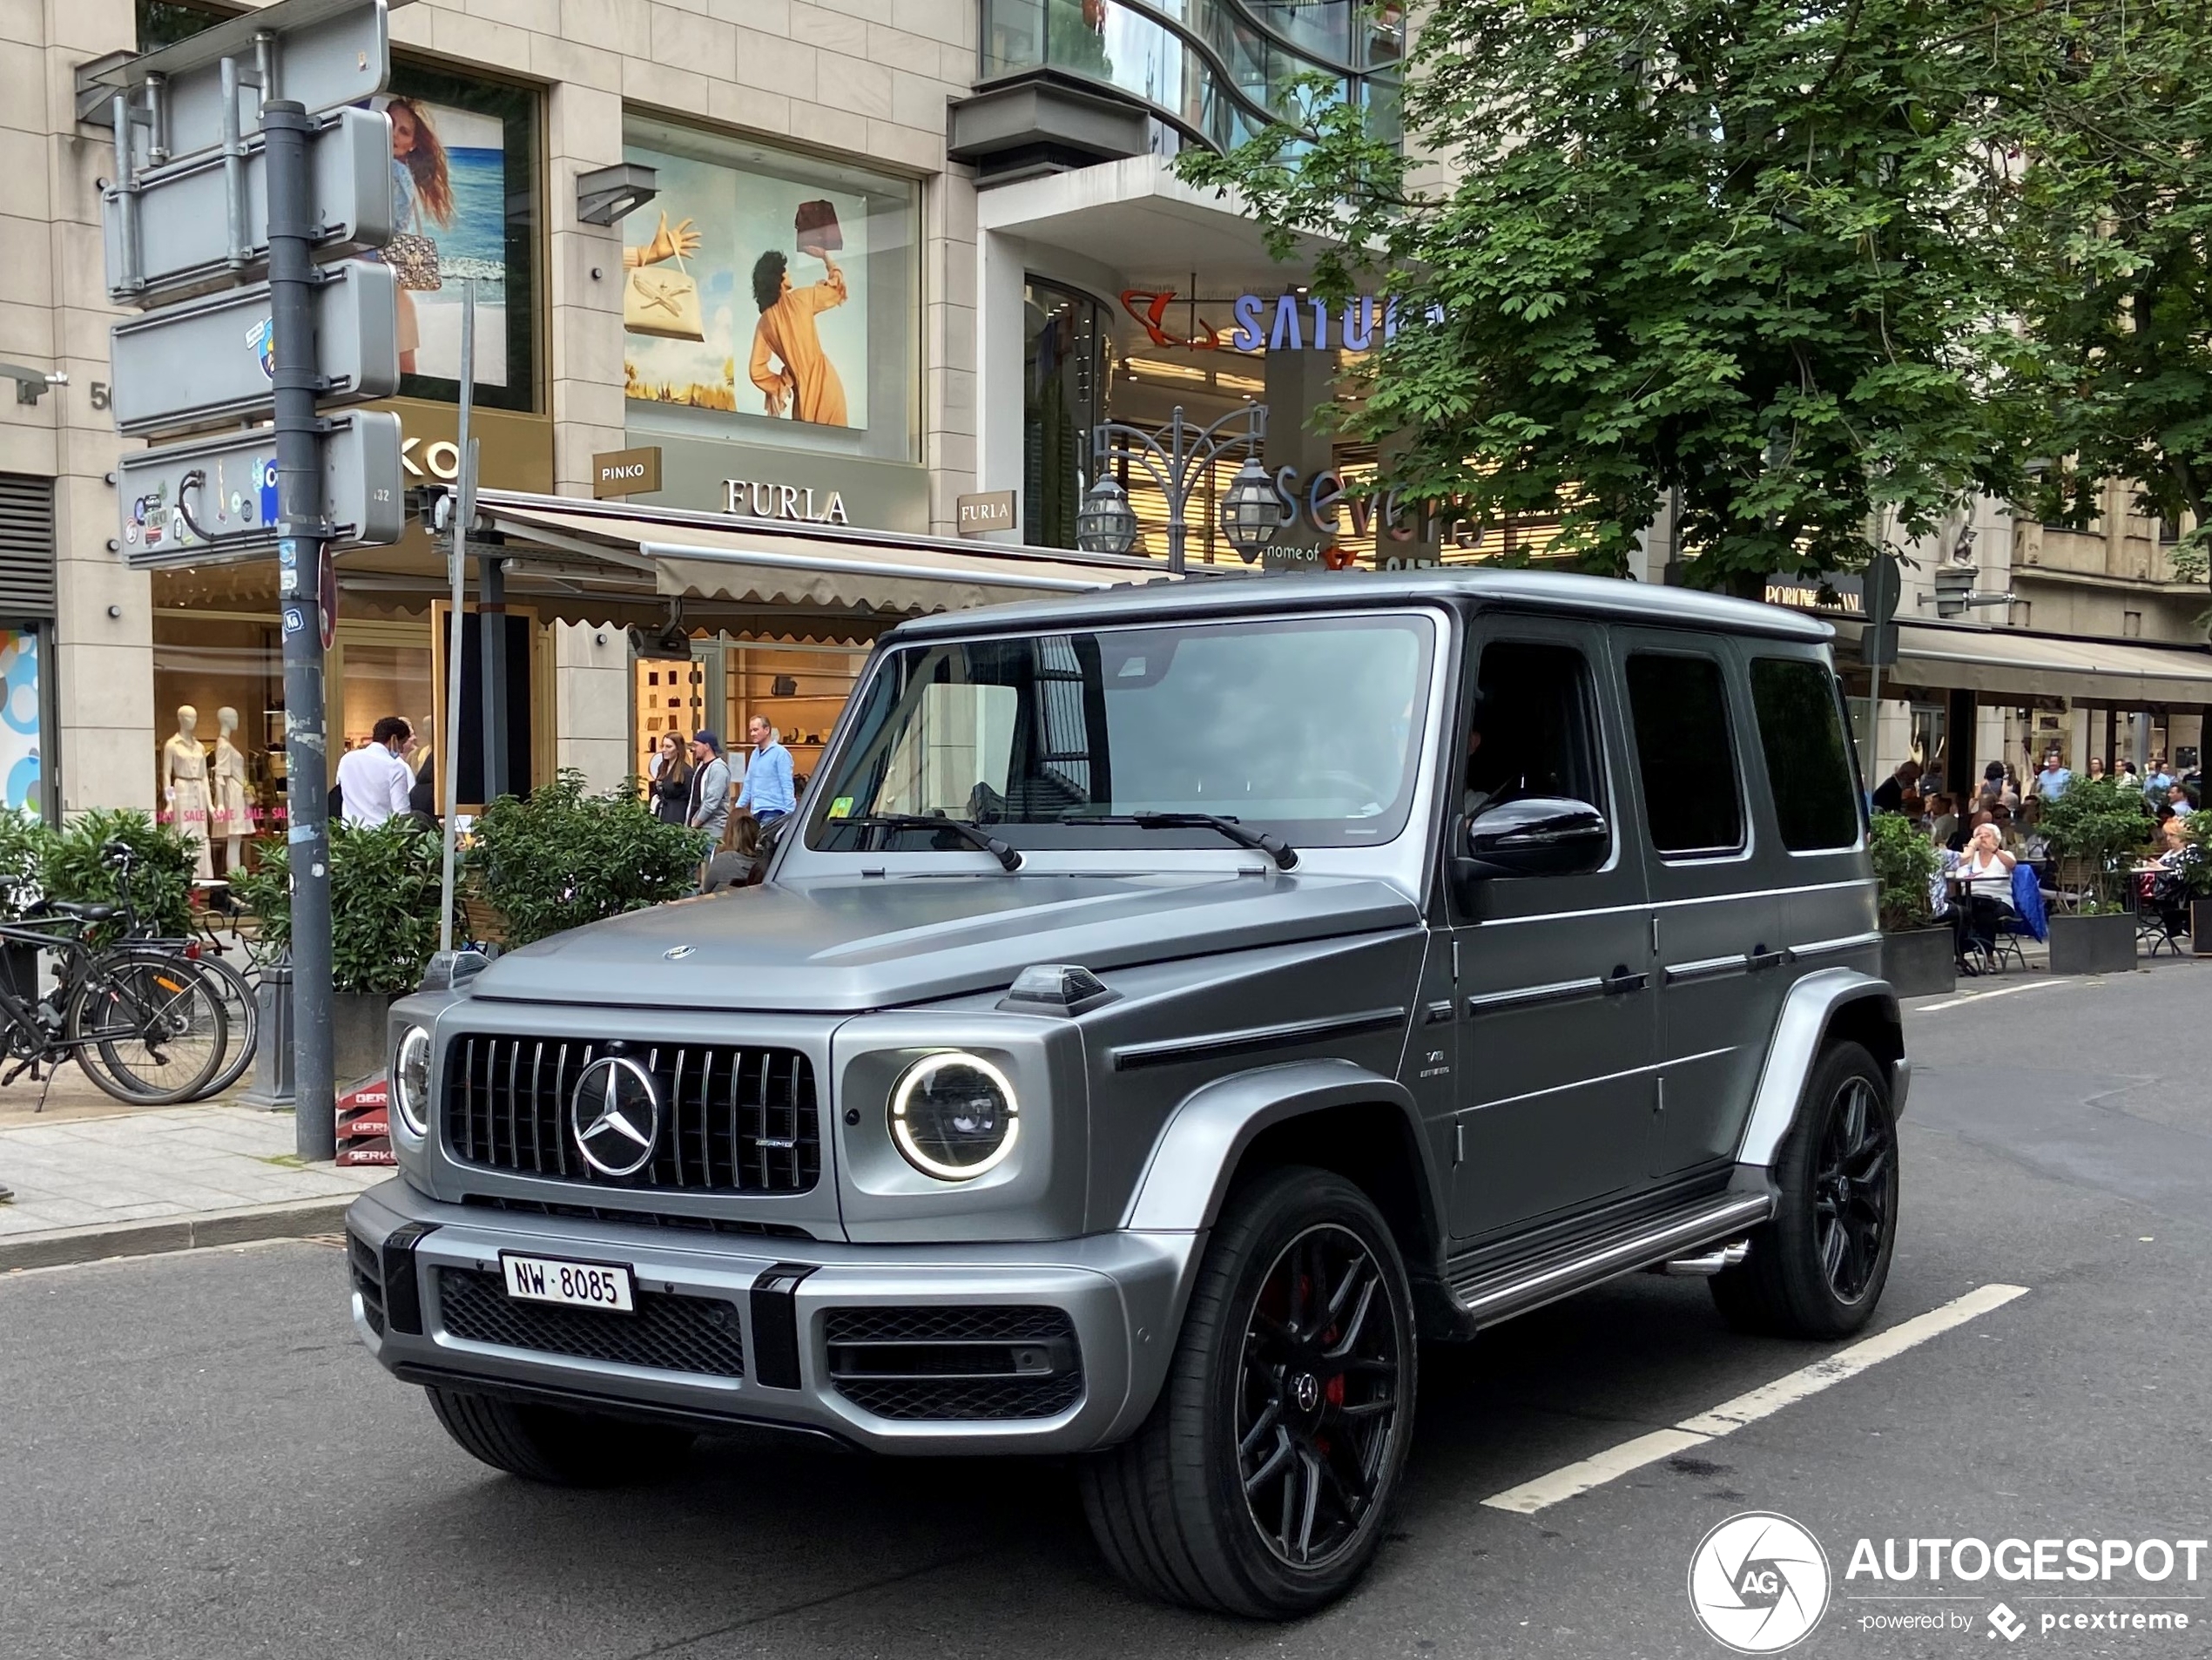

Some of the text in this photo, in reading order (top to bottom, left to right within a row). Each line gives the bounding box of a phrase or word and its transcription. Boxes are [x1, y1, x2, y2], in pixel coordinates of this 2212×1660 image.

[602, 463, 644, 481] PINKO
[724, 478, 850, 524] FURLA
[961, 503, 1008, 521] FURLA
[1306, 542, 1319, 562] of
[184, 810, 206, 821] SALE
[244, 807, 265, 820] SALE
[515, 1262, 617, 1303] NW 8085
